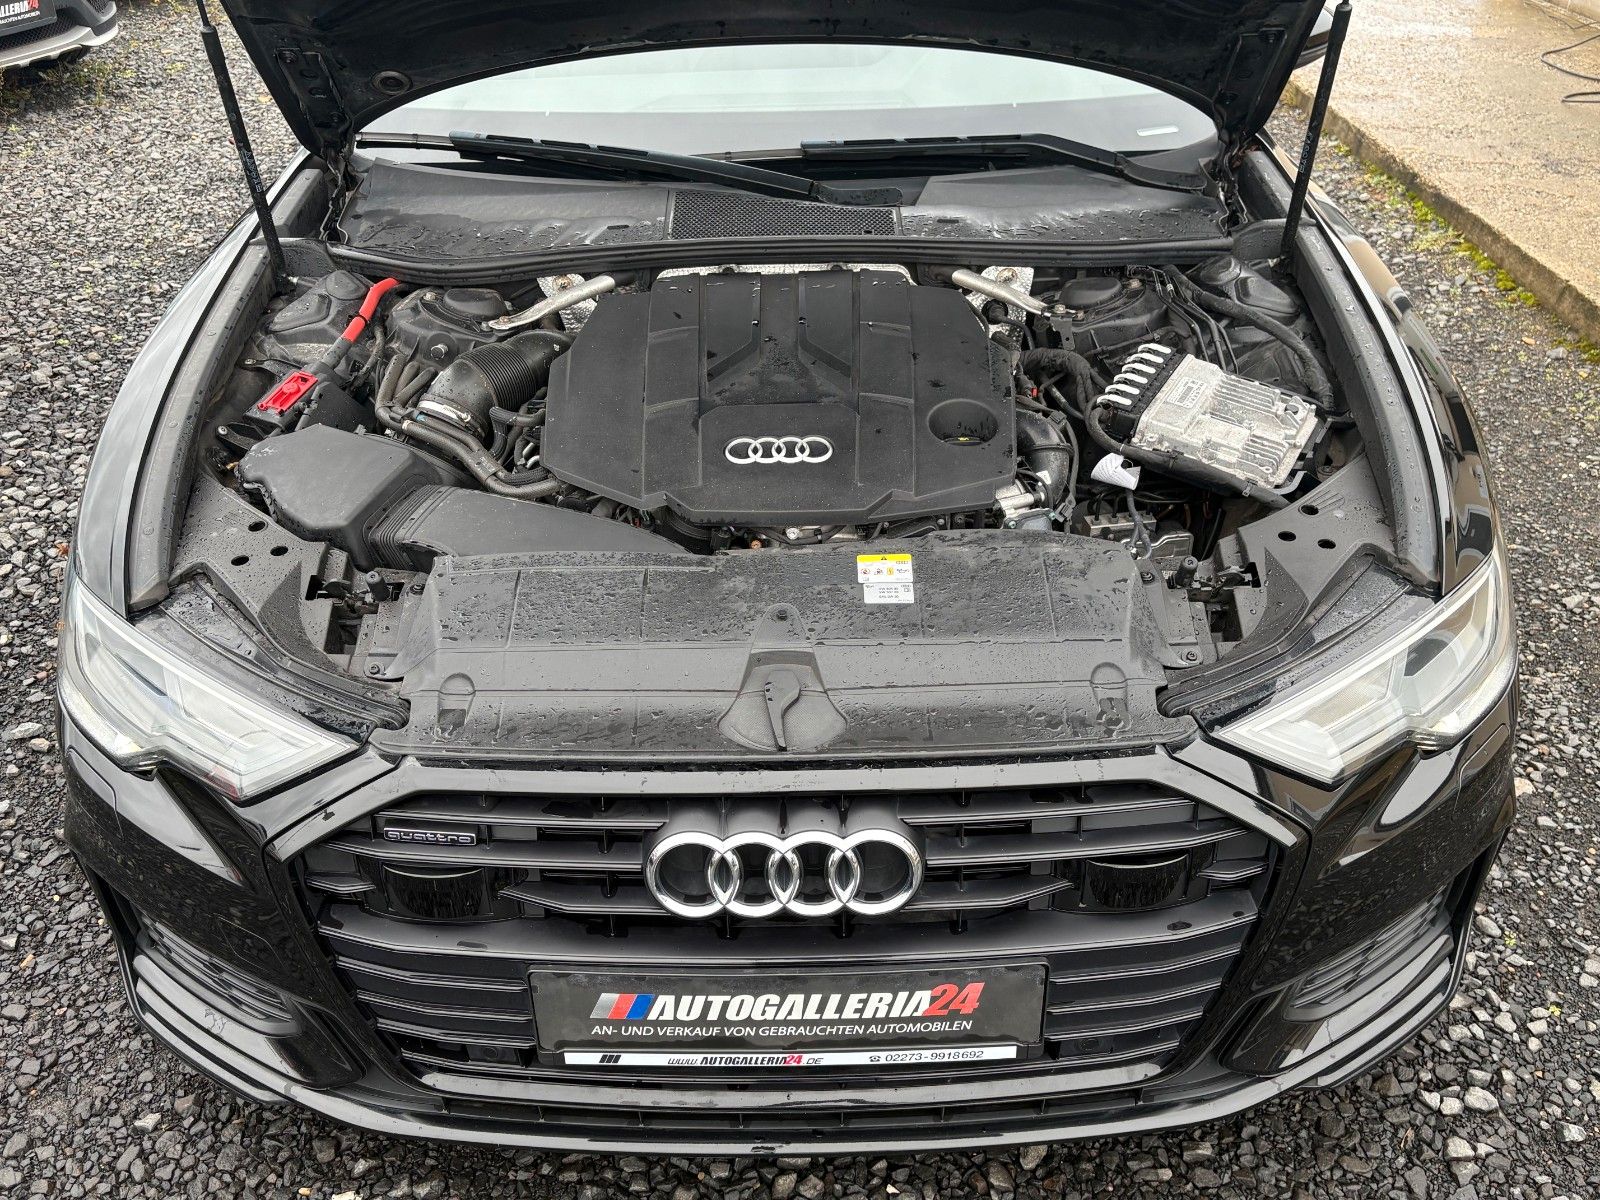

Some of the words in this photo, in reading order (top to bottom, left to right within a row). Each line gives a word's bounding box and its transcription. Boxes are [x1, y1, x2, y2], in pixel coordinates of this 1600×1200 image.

[387, 831, 471, 843] quattro
[646, 982, 985, 1021] AUTOGALLERIA24
[591, 1025, 618, 1036] AN-
[621, 1026, 654, 1036] UND
[657, 1026, 721, 1037] VERKAUF
[723, 1026, 756, 1037] VON
[759, 1024, 865, 1037] GEBRAUCHTEN
[866, 1020, 973, 1035] AUTOMOBILEN
[885, 1050, 984, 1062] 02273-9918692
